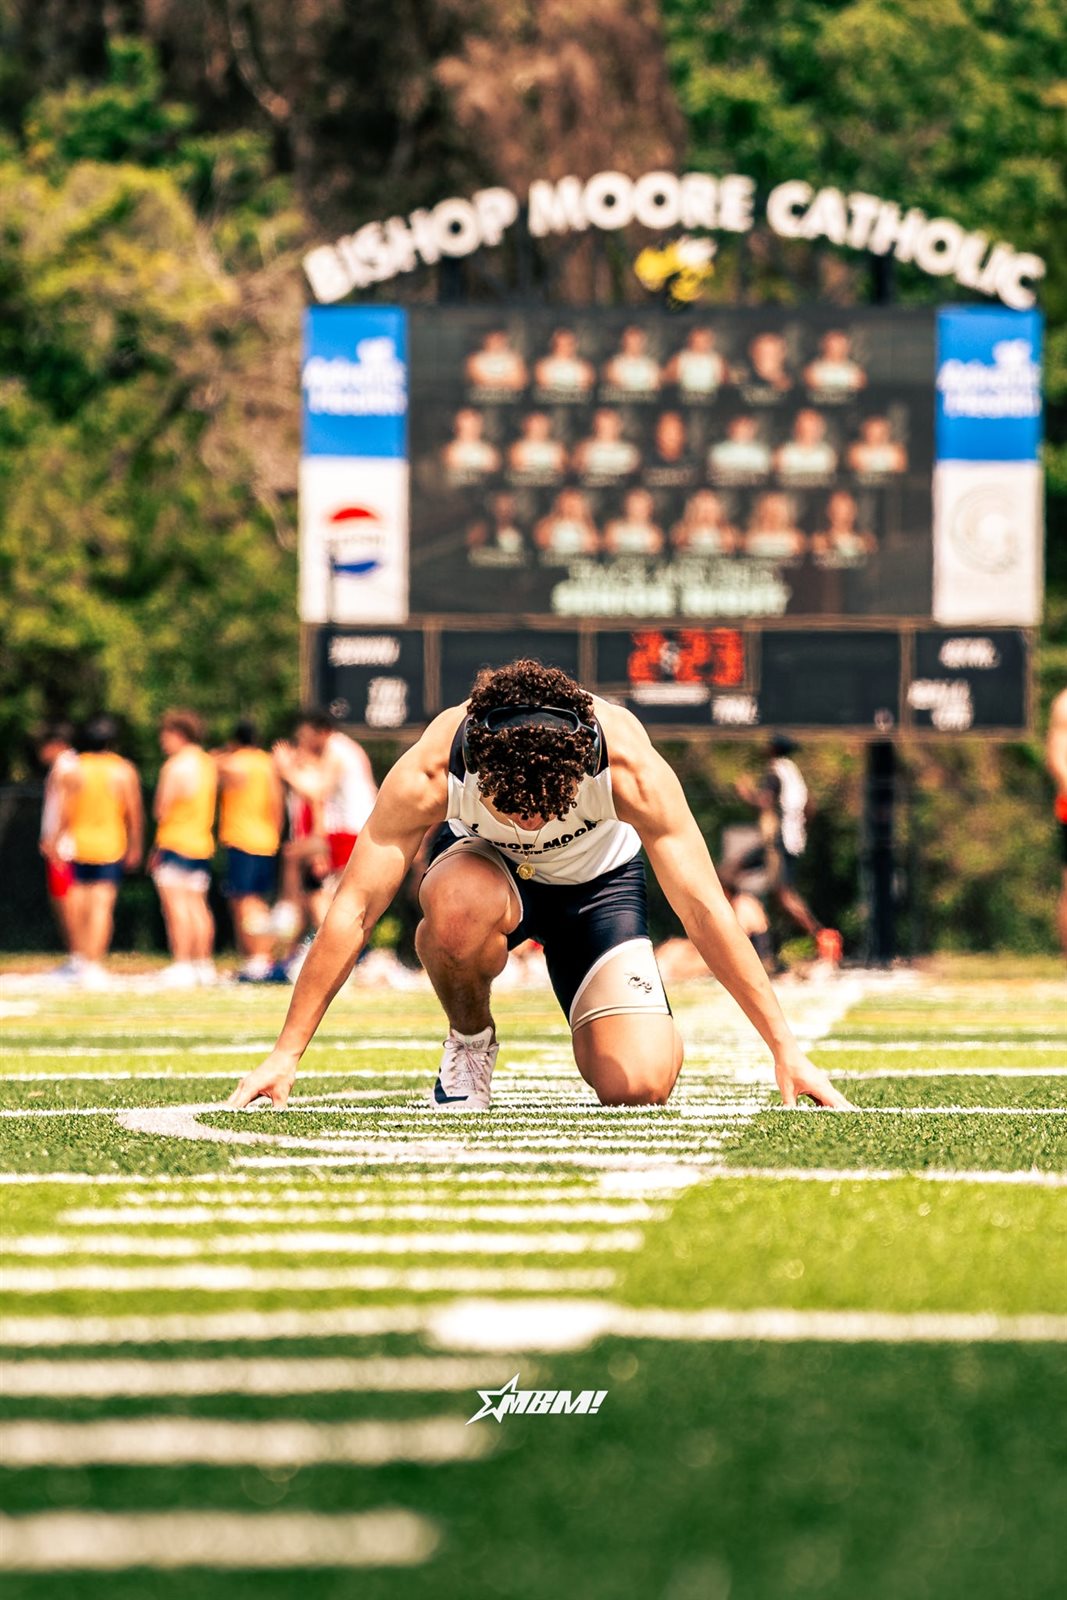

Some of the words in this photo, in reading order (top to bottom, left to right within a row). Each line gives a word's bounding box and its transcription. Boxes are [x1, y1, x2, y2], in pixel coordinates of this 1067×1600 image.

[302, 186, 519, 304] BISHOP
[528, 170, 756, 237] MOORE
[766, 179, 1046, 312] CATHOLIC
